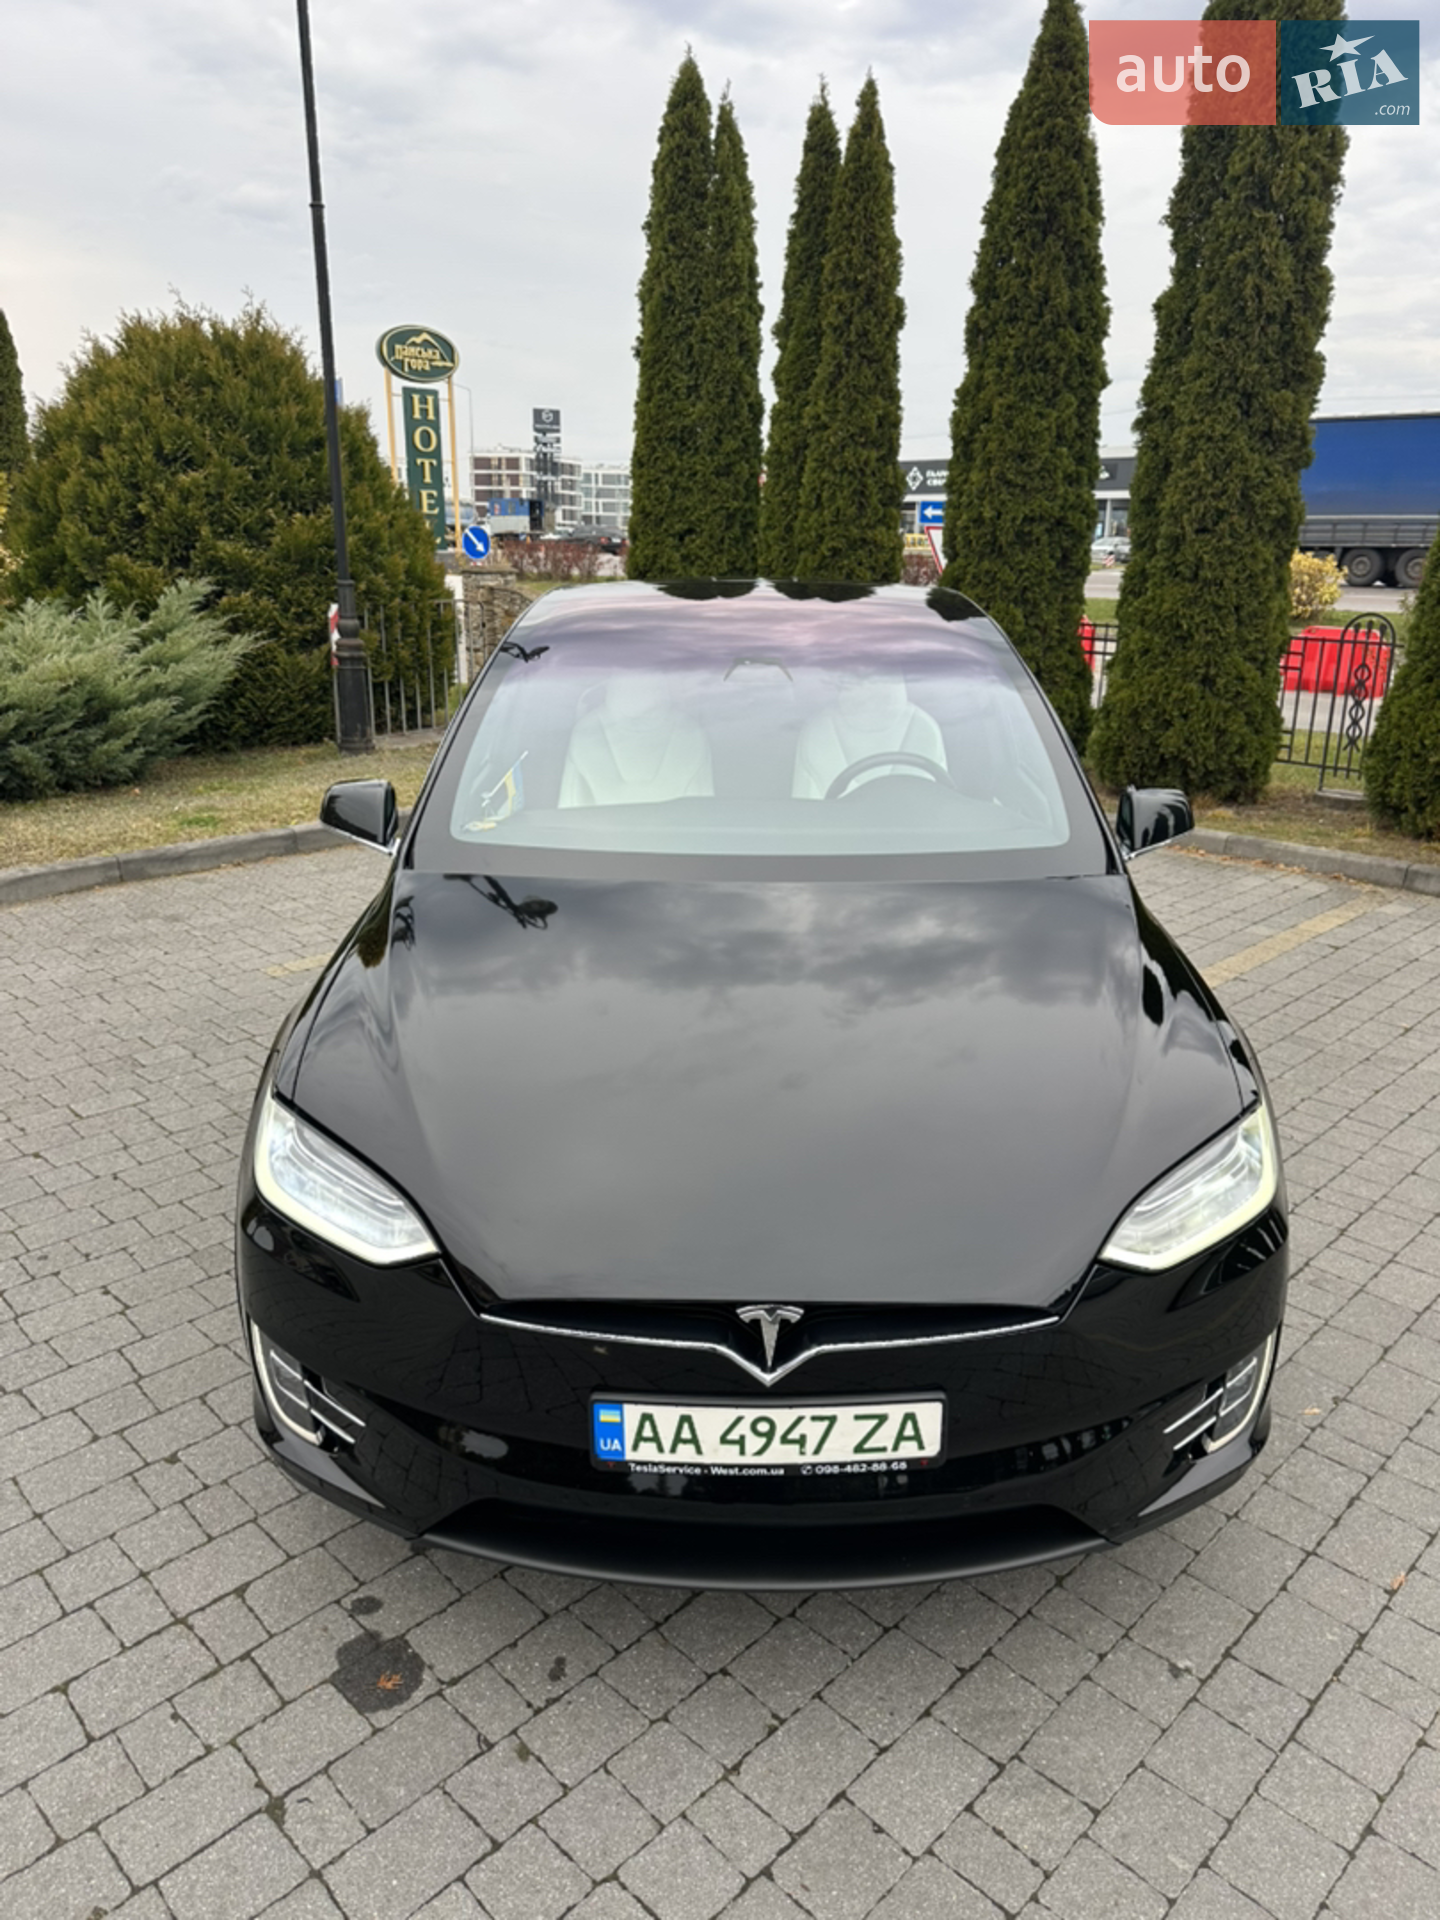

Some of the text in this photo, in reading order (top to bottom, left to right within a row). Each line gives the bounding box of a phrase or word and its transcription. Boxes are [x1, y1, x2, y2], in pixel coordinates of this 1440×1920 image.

[411, 393, 442, 545] HOTE
[600, 1438, 622, 1452] UA
[630, 1411, 926, 1457] AA 4947 ZA
